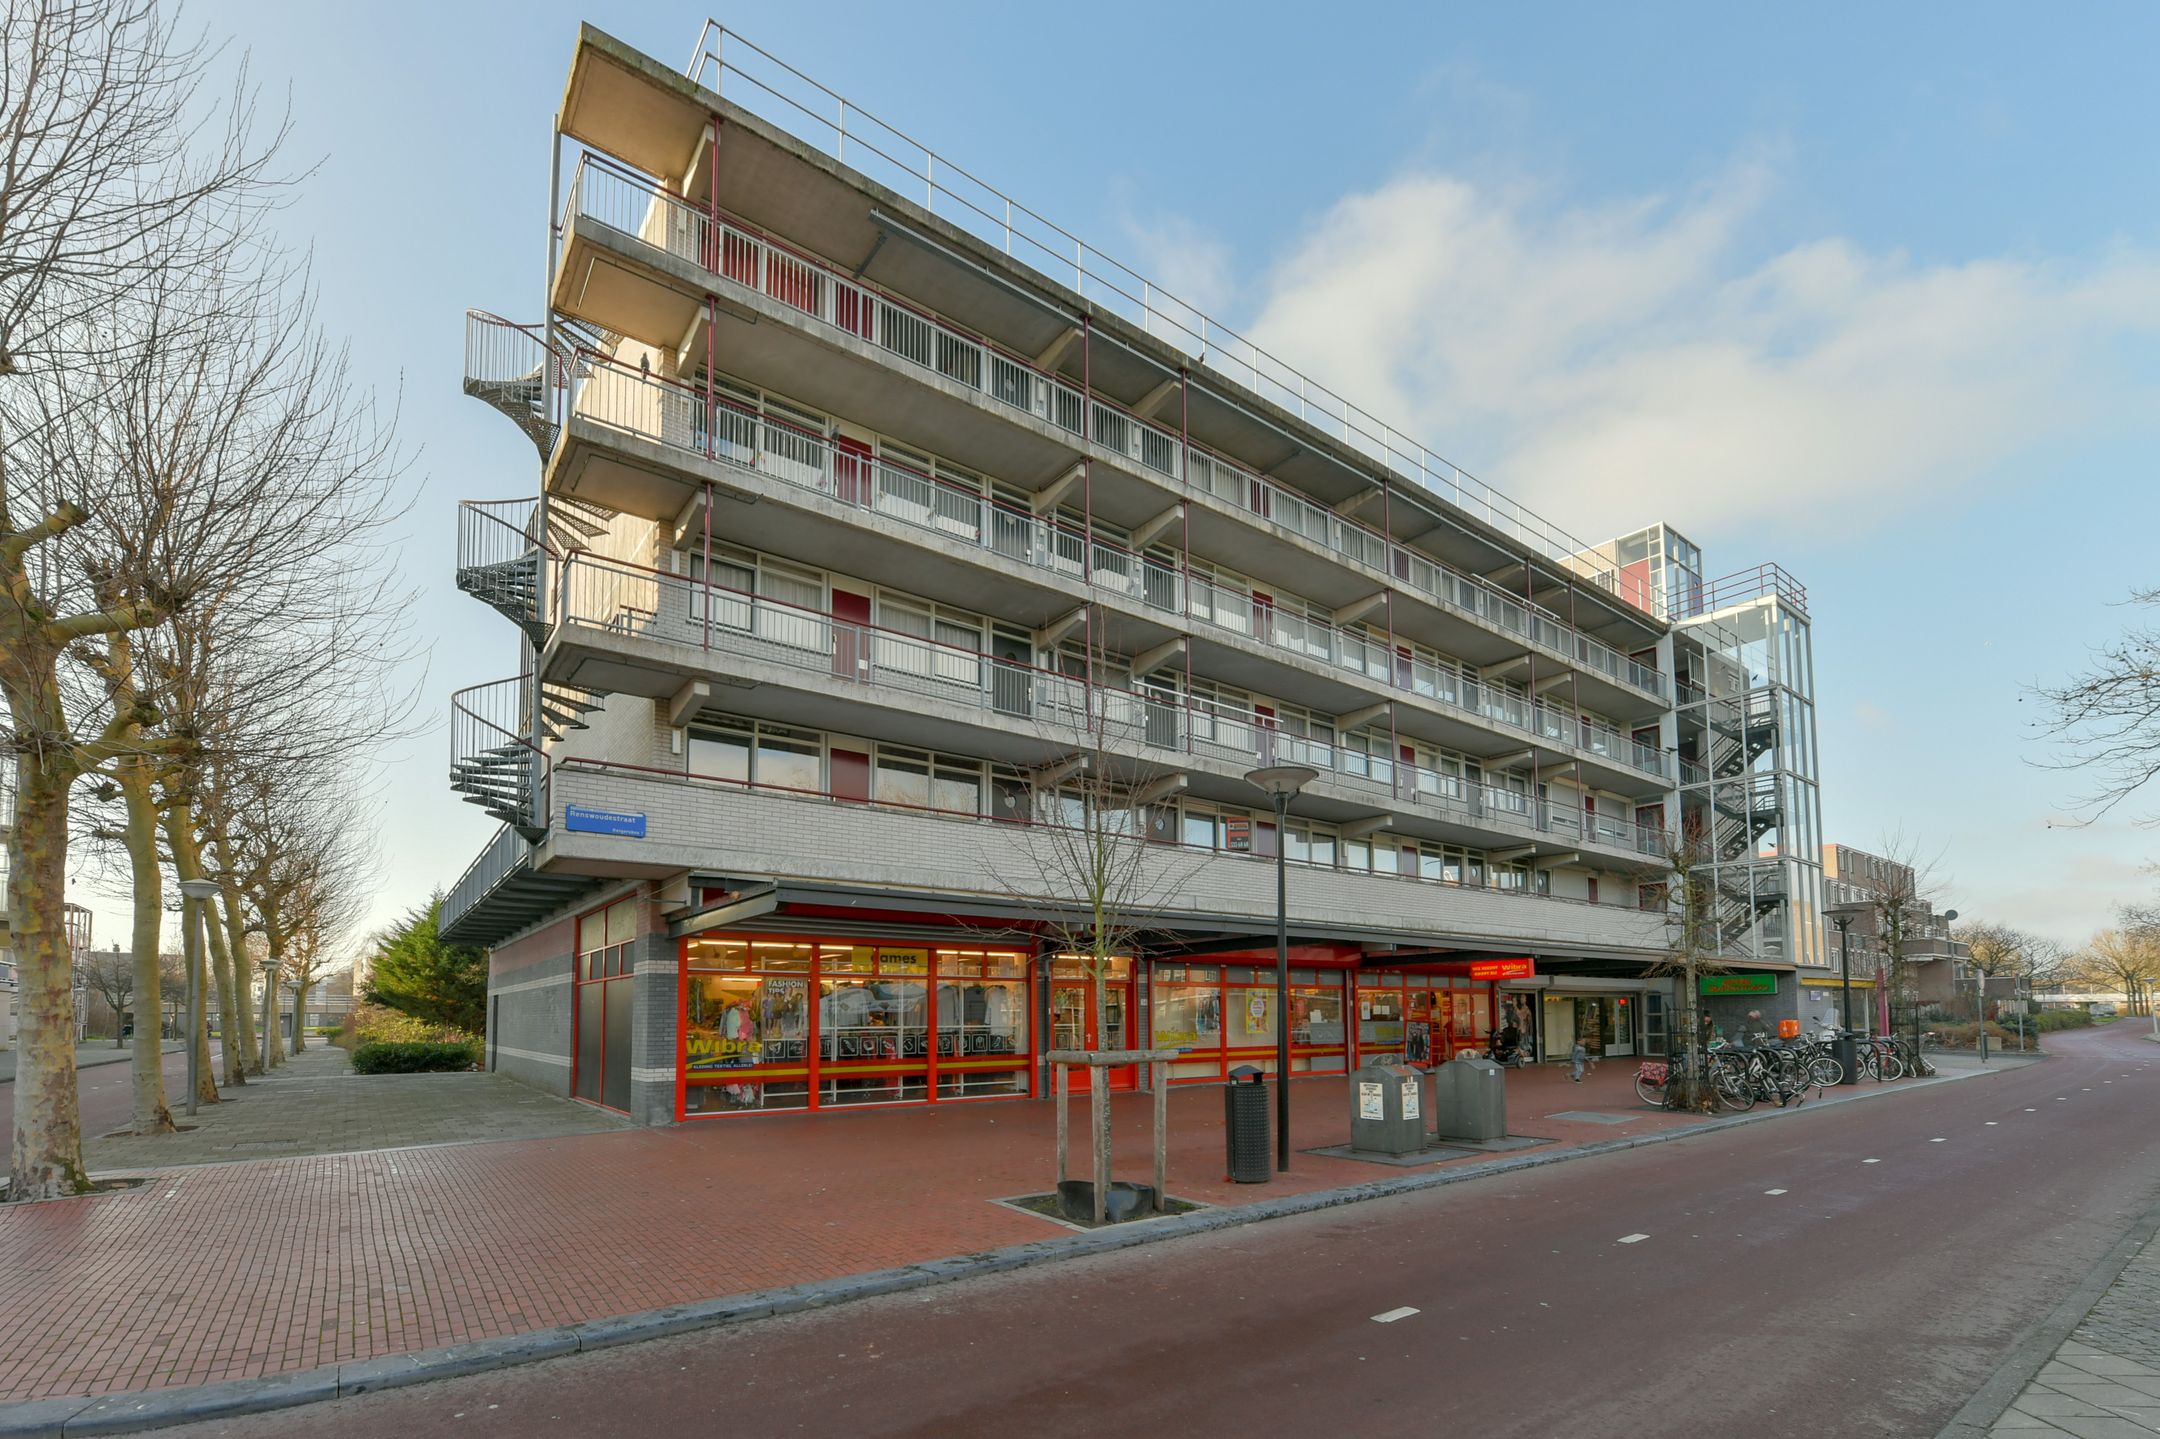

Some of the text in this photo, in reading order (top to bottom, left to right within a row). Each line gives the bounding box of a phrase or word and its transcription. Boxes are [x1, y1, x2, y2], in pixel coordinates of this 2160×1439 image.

[570, 810, 636, 824] Renswoudestraat
[871, 954, 917, 964] ames
[768, 980, 804, 988] FASHION
[686, 1038, 762, 1054] Wibra
